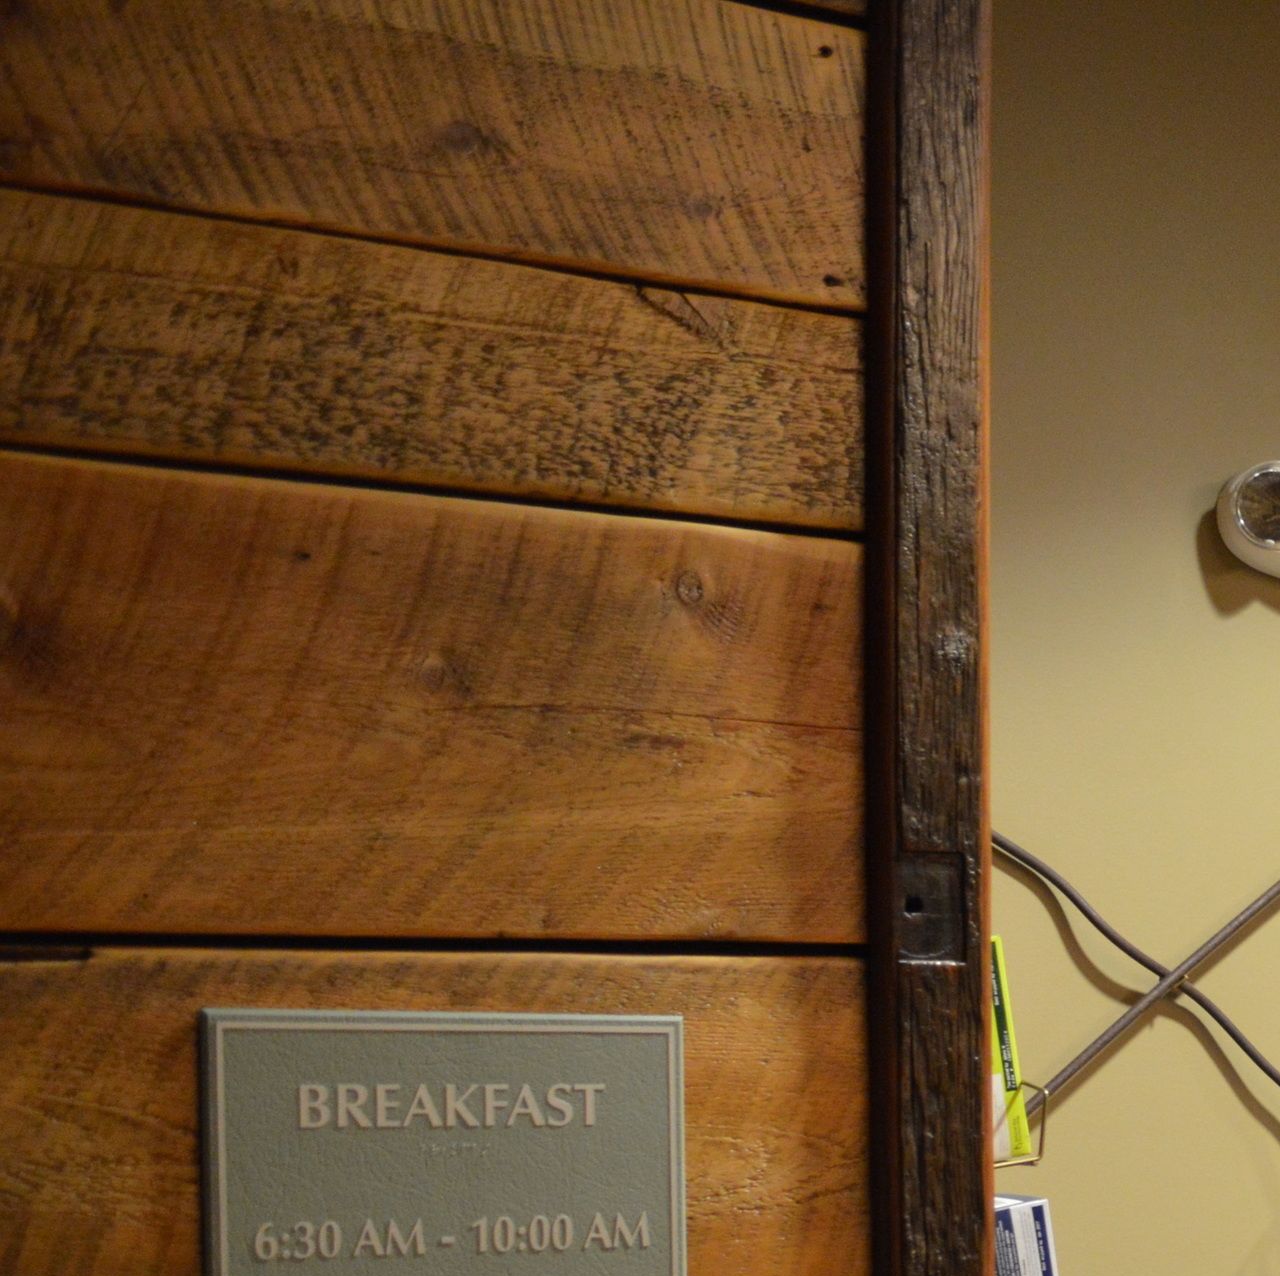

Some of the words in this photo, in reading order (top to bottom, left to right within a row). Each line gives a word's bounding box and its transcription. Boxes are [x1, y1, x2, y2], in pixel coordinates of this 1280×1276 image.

[299, 1083, 606, 1130] BREAKFAST
[254, 1220, 342, 1260] 6:30
[353, 1218, 426, 1257] AM
[472, 1214, 574, 1253] 10:00
[583, 1211, 652, 1250] AM
